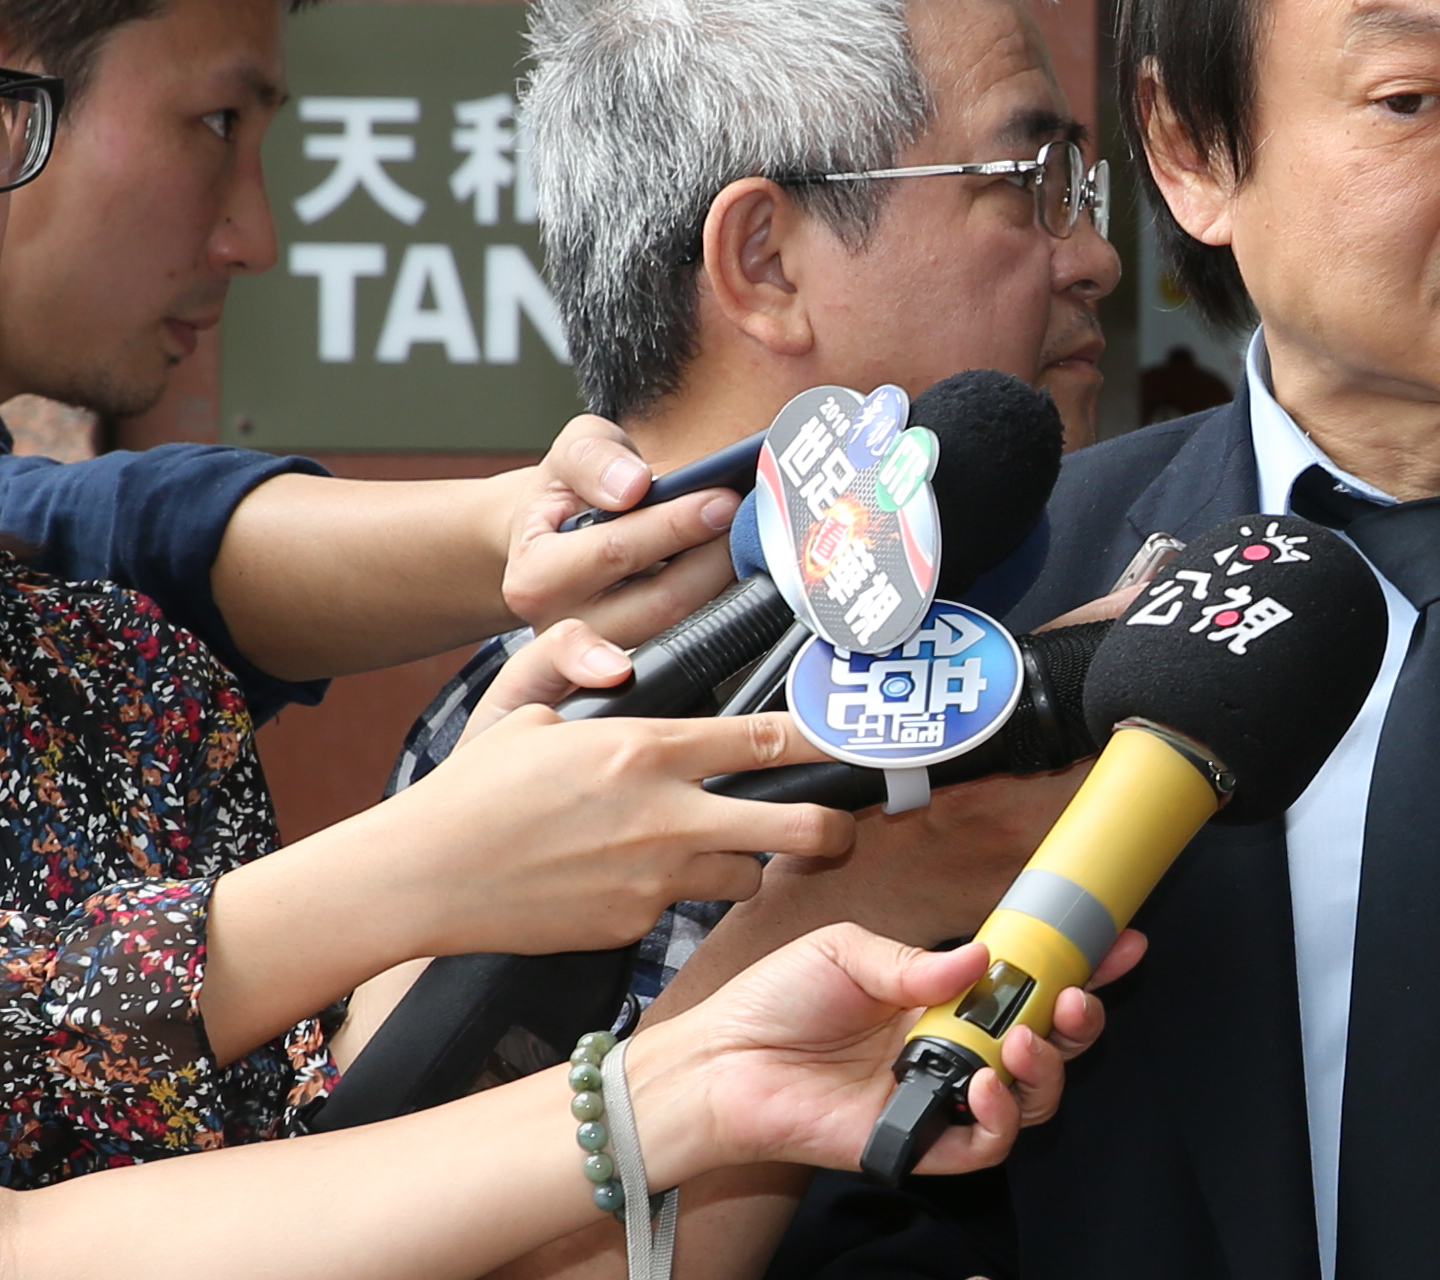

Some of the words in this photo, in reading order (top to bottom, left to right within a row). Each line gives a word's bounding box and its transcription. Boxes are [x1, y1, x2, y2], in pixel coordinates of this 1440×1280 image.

[819, 396, 852, 438] 2018
[878, 434, 930, 507] CTS
[1126, 569, 1294, 655] 公視
